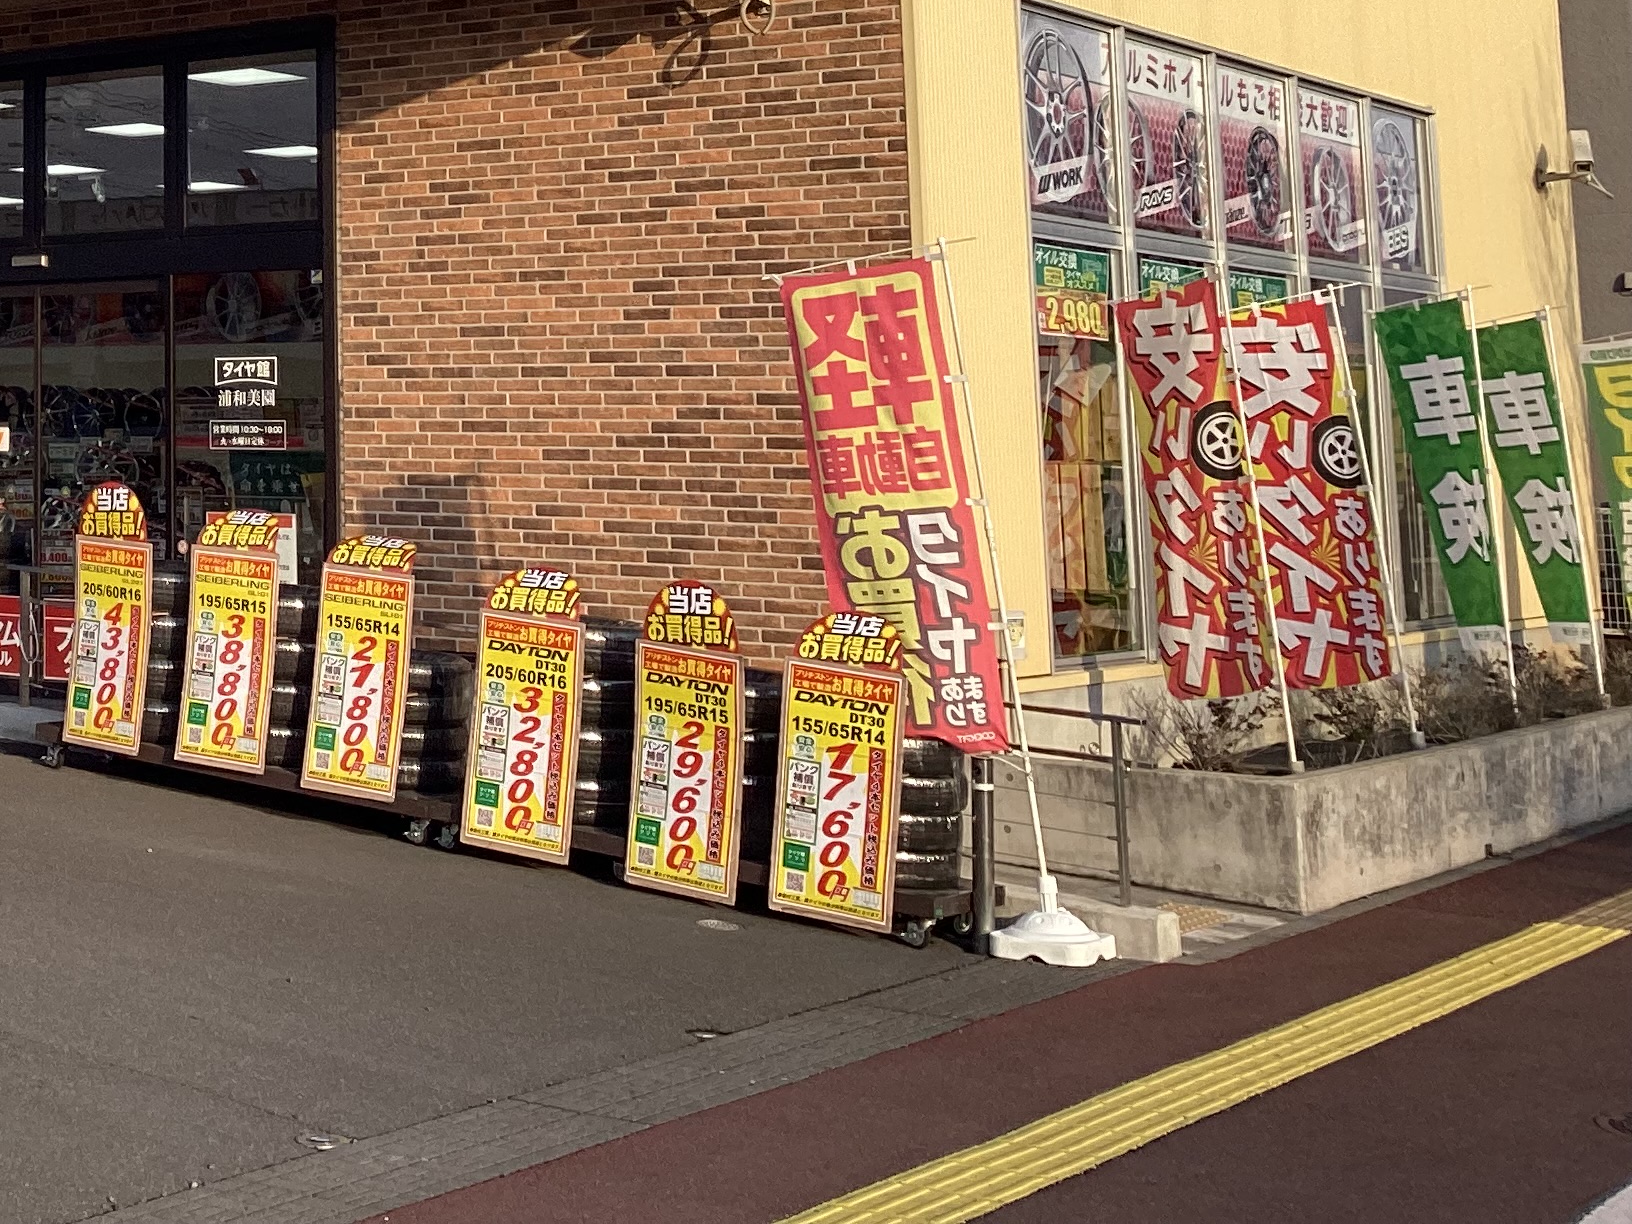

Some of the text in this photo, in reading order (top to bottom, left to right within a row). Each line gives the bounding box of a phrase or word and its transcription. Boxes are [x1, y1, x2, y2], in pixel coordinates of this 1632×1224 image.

[1053, 166, 1083, 188] WORK
[1035, 247, 1077, 270] オイル交換
[1230, 275, 1263, 294] オイル交換
[222, 360, 271, 378] タイヤ館
[218, 389, 276, 407] 浦和美園
[97, 487, 129, 511] 当店
[82, 511, 145, 536] お買得品!
[228, 510, 272, 526] 当店
[201, 523, 279, 546] お買得品!
[362, 535, 409, 549] 当店
[332, 543, 416, 568] お買得品!
[80, 562, 144, 578] SEIBERLING
[226, 560, 271, 577] お買得タイヤ
[520, 569, 569, 590] 当店
[82, 582, 142, 601] 205/60R16
[196, 574, 270, 590] SEIBERLING
[357, 579, 405, 598] お買得タイヤ
[199, 593, 266, 614] 195/65R15
[323, 593, 404, 612] SEIBERLING
[490, 585, 580, 615] お買得品!
[669, 586, 712, 614] 当店
[326, 613, 400, 636] 155/65R14
[647, 613, 733, 646] お買得品!
[831, 613, 885, 637] 当店
[520, 626, 572, 648] お買得タイヤ
[799, 632, 902, 664] お買得品!
[487, 639, 570, 662] DAYTON
[485, 663, 567, 689] 205/60R16
[535, 660, 566, 673] DT30
[678, 658, 732, 681] お買得タイヤ
[646, 671, 729, 696] DAYTON
[832, 676, 894, 701] お買得タイヤ
[644, 696, 729, 724] 195/65R15
[695, 693, 727, 707] DT30
[794, 690, 890, 717] DAYTON
[792, 716, 886, 745] 155/65R14
[849, 712, 885, 728] DT30
